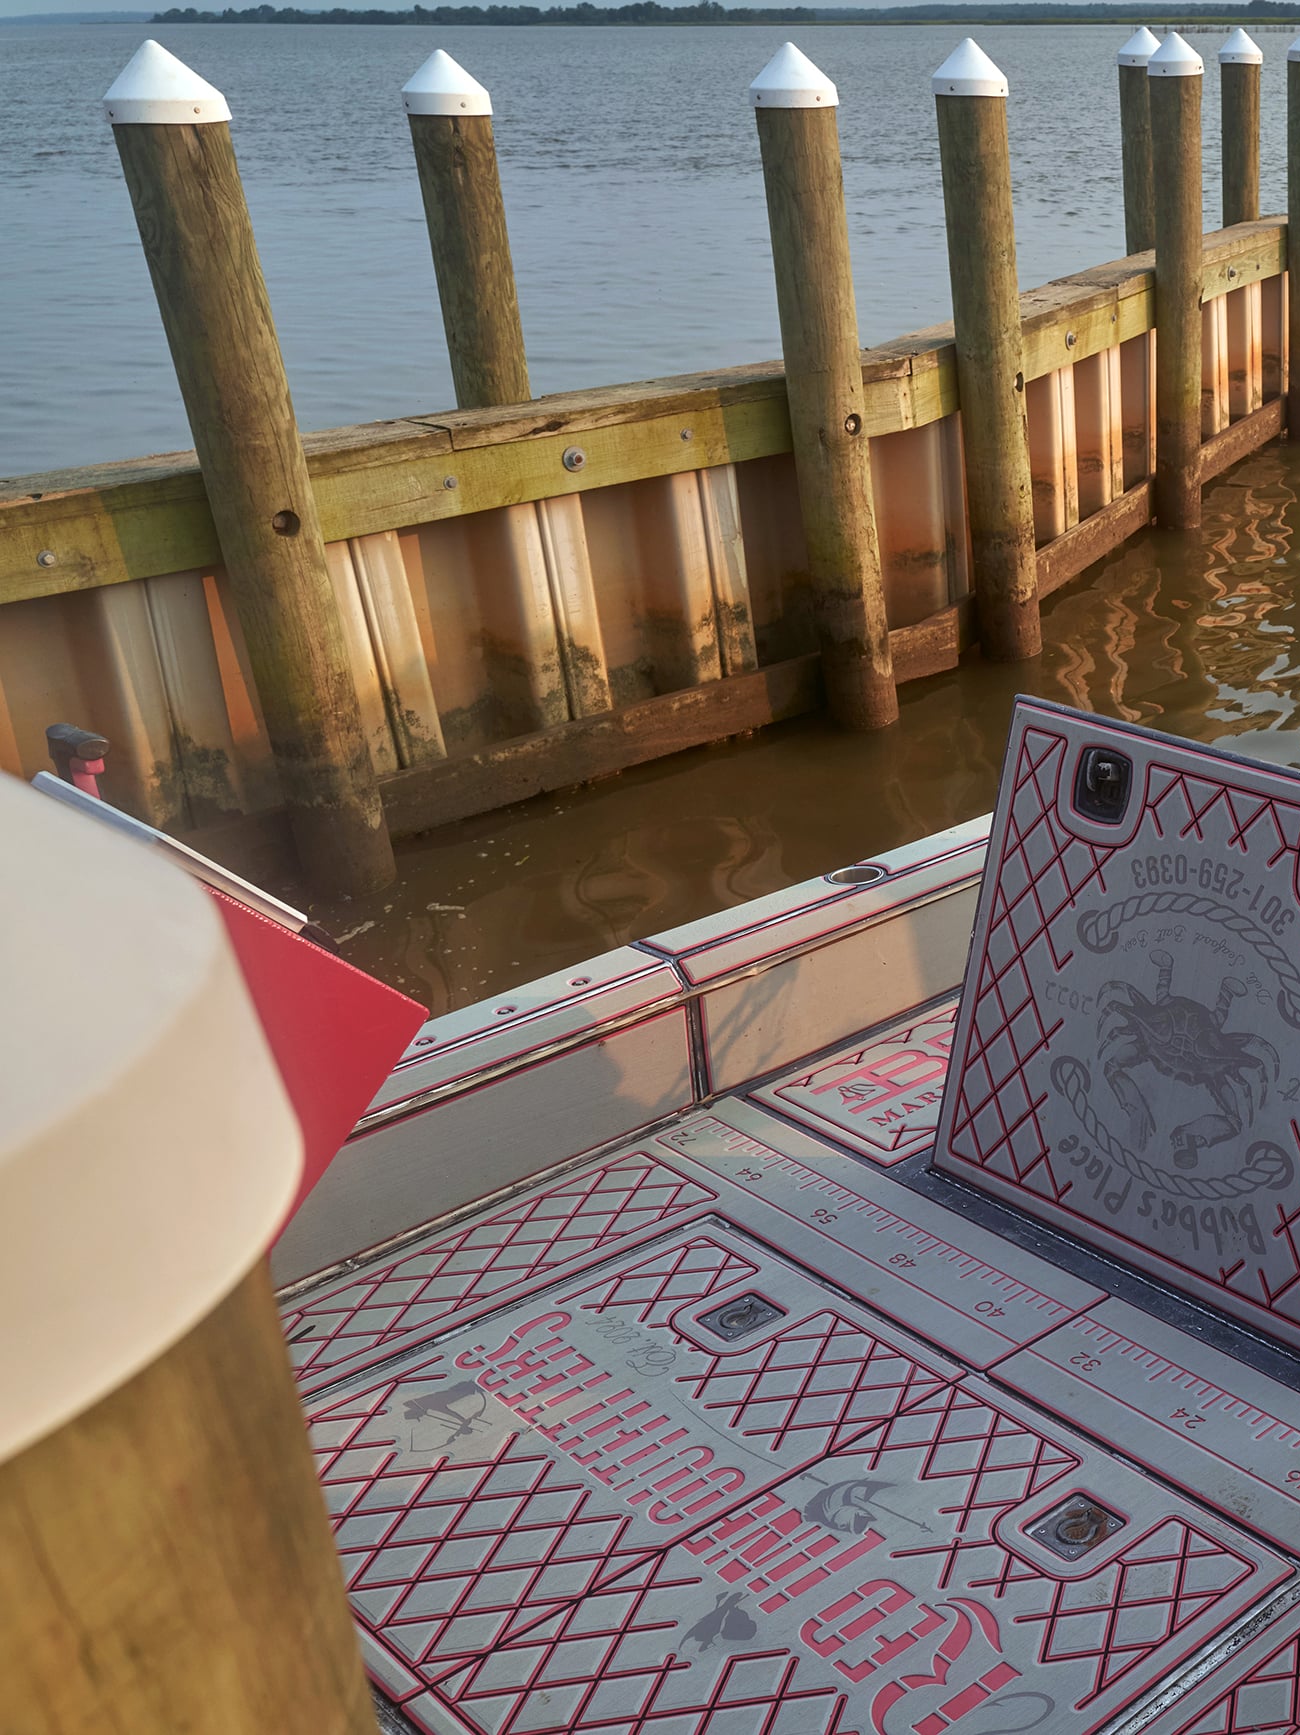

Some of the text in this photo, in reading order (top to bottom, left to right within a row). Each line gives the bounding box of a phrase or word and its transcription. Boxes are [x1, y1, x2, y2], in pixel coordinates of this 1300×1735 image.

[1131, 853, 1295, 936] 301-259-0393
[1120, 929, 1148, 952] Beer
[1154, 924, 1187, 944] Bait
[1192, 931, 1247, 967] Seafood
[1044, 979, 1095, 1015] 2022
[670, 1131, 697, 1146] 72
[734, 1166, 764, 1183] 64
[1057, 1134, 1267, 1256] Bubba's Place
[808, 1207, 839, 1227] 56
[888, 1252, 917, 1270] 48
[973, 1299, 1007, 1320] 40
[584, 1315, 641, 1345] 2024
[1068, 1350, 1102, 1372] 32
[1169, 1407, 1206, 1430] 24
[454, 1311, 1023, 1735] RED LINE OUTFITTERS
